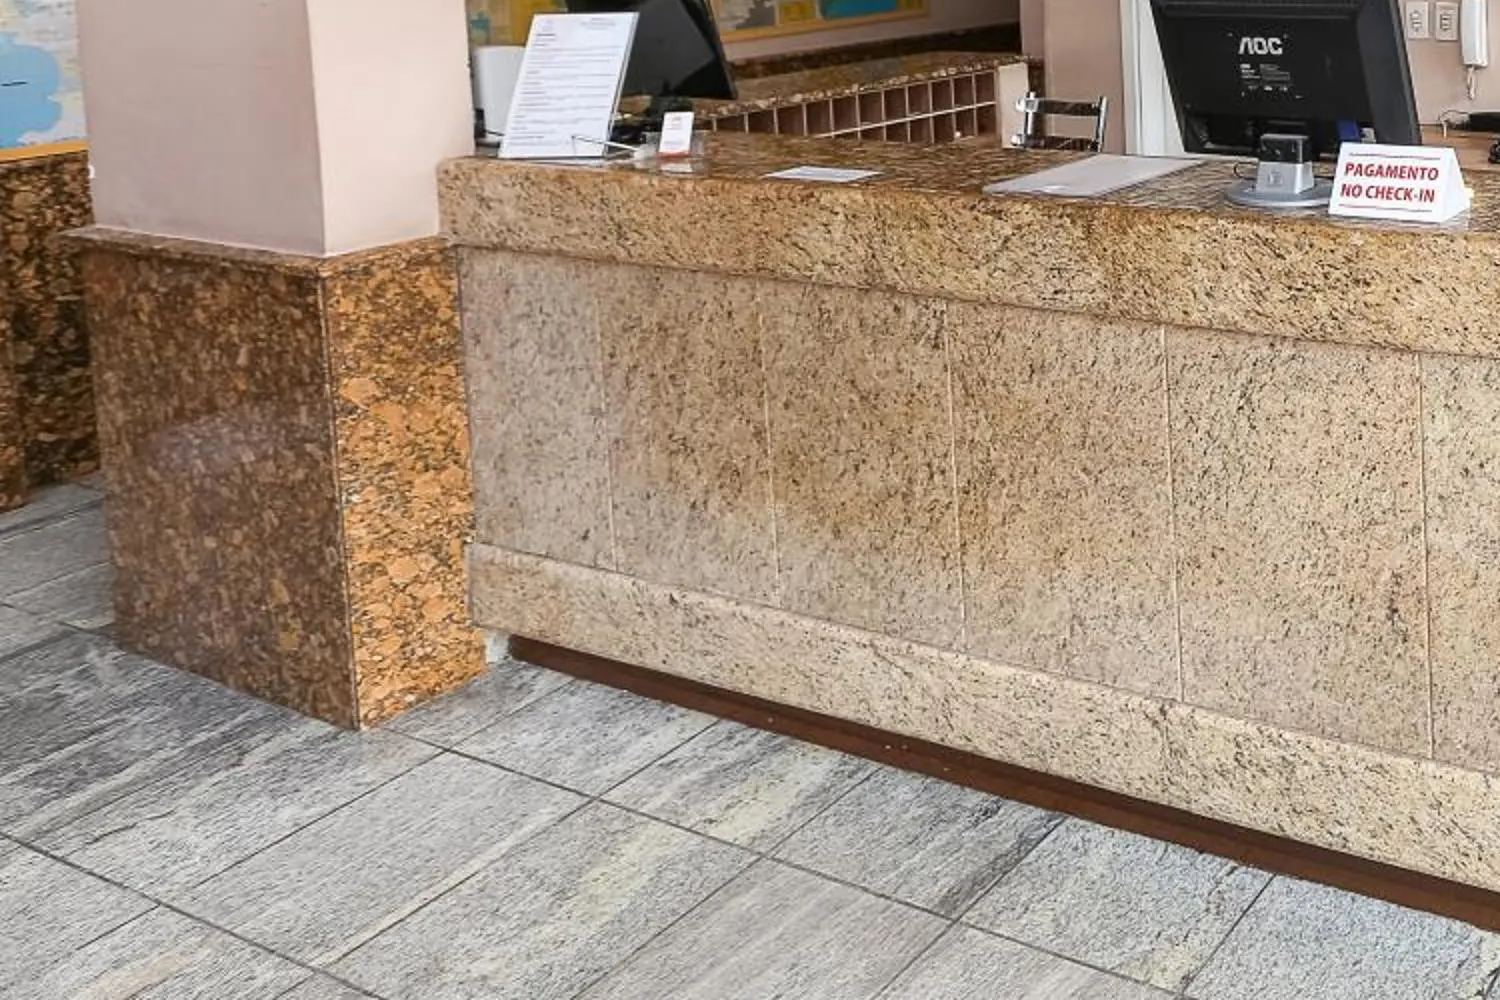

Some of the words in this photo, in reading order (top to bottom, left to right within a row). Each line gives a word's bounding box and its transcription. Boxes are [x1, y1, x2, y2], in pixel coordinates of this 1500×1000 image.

[1238, 37, 1283, 54] AOC
[1344, 163, 1439, 181] PAGAMENTO
[1341, 183, 1362, 198] NO
[1365, 185, 1435, 203] CHECK-IN
